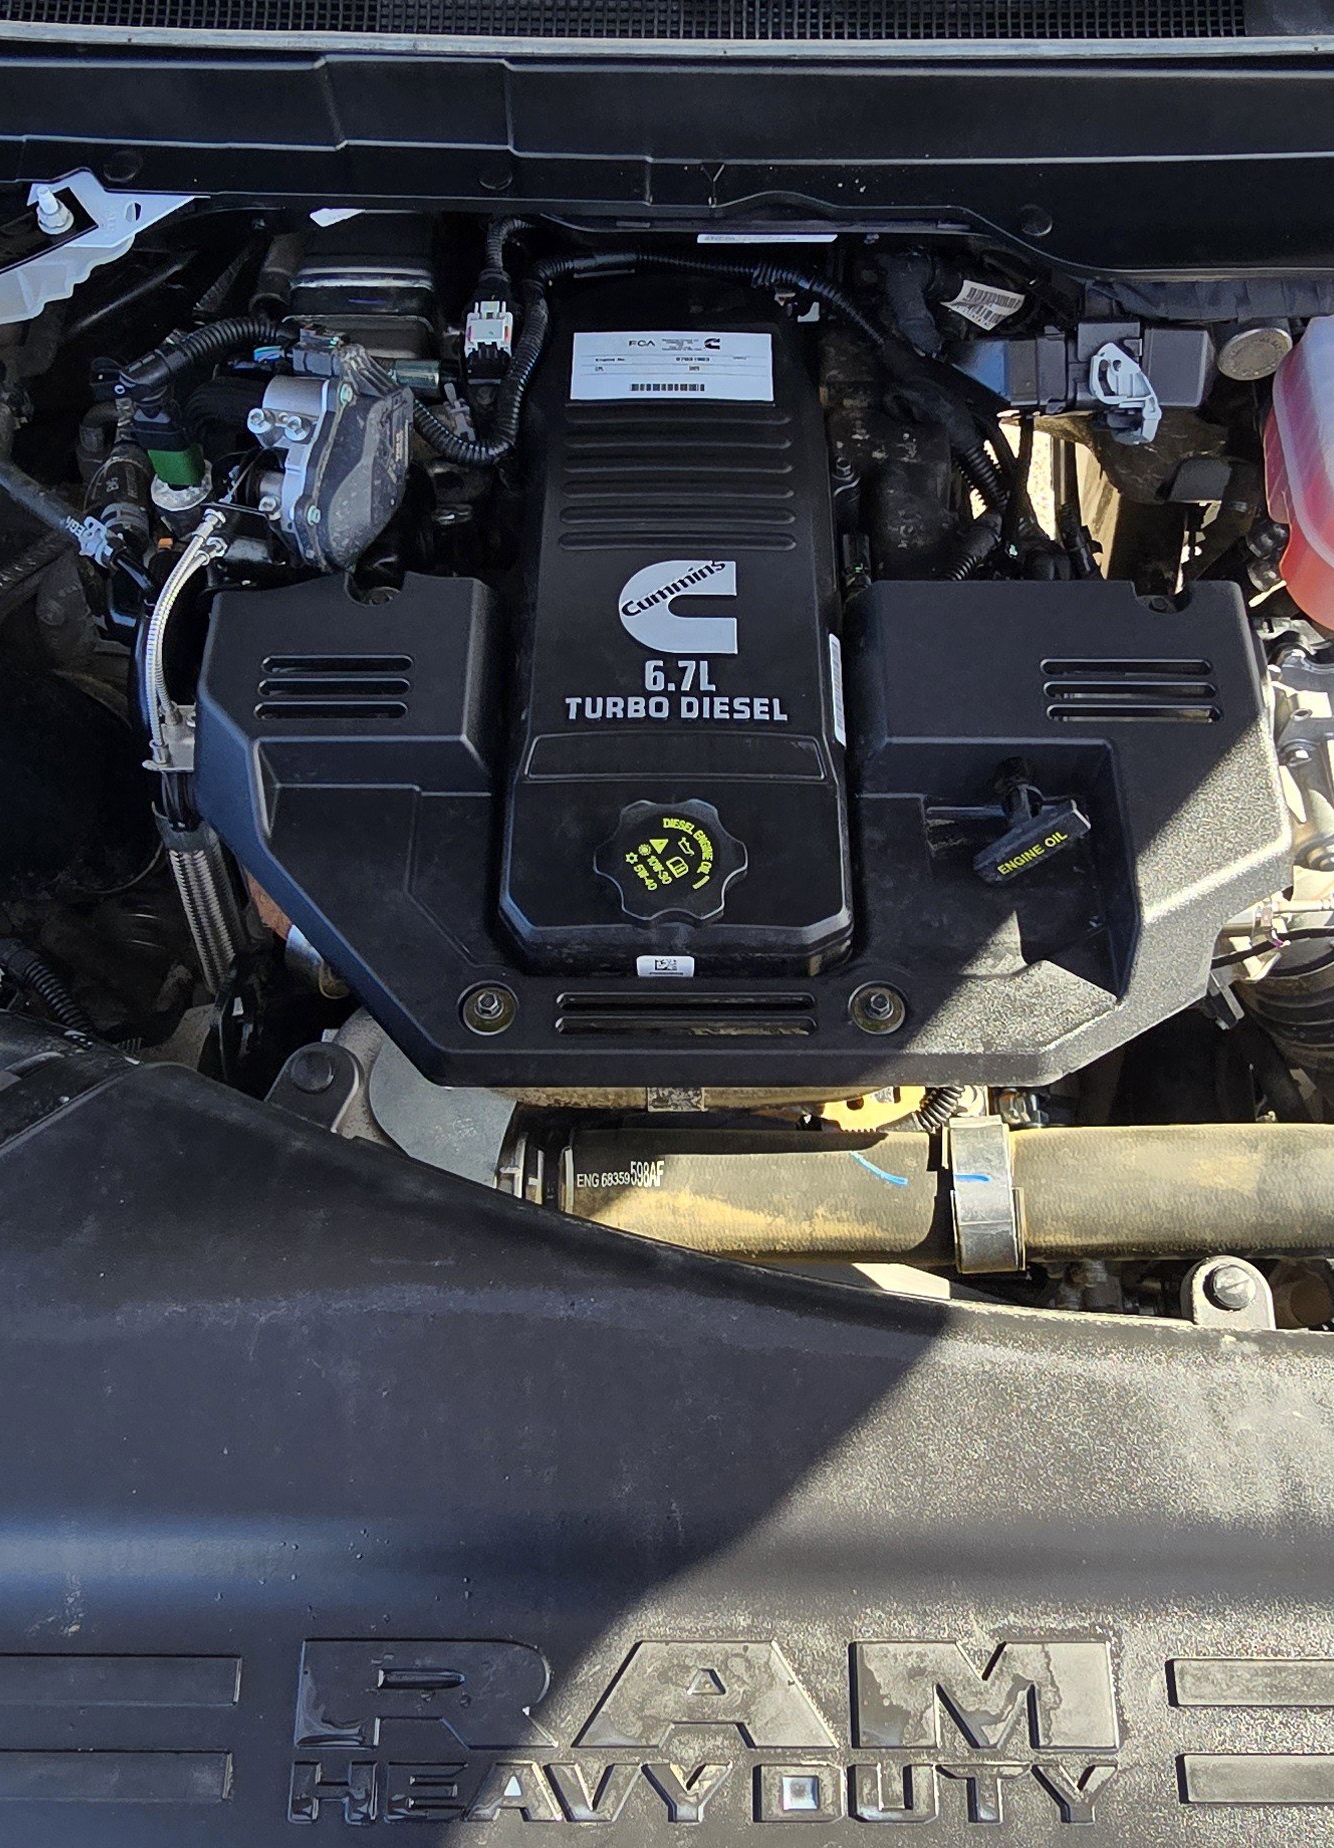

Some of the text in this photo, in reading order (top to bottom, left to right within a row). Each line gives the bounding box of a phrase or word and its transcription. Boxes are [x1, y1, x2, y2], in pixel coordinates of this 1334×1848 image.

[622, 561, 726, 617] Cummins
[645, 660, 716, 692] 6.7L
[565, 696, 789, 722] TURBO DIESEL
[663, 818, 694, 835] DIESEL
[693, 830, 713, 861] ENGINE
[997, 831, 1068, 875] ENGINE OIL
[633, 864, 658, 891] 5W-40
[647, 855, 673, 885] 10W-30
[577, 1173, 600, 1188] ENG
[294, 1638, 1120, 1750] RAM
[288, 1761, 1119, 1824] HEAVY DUTY
